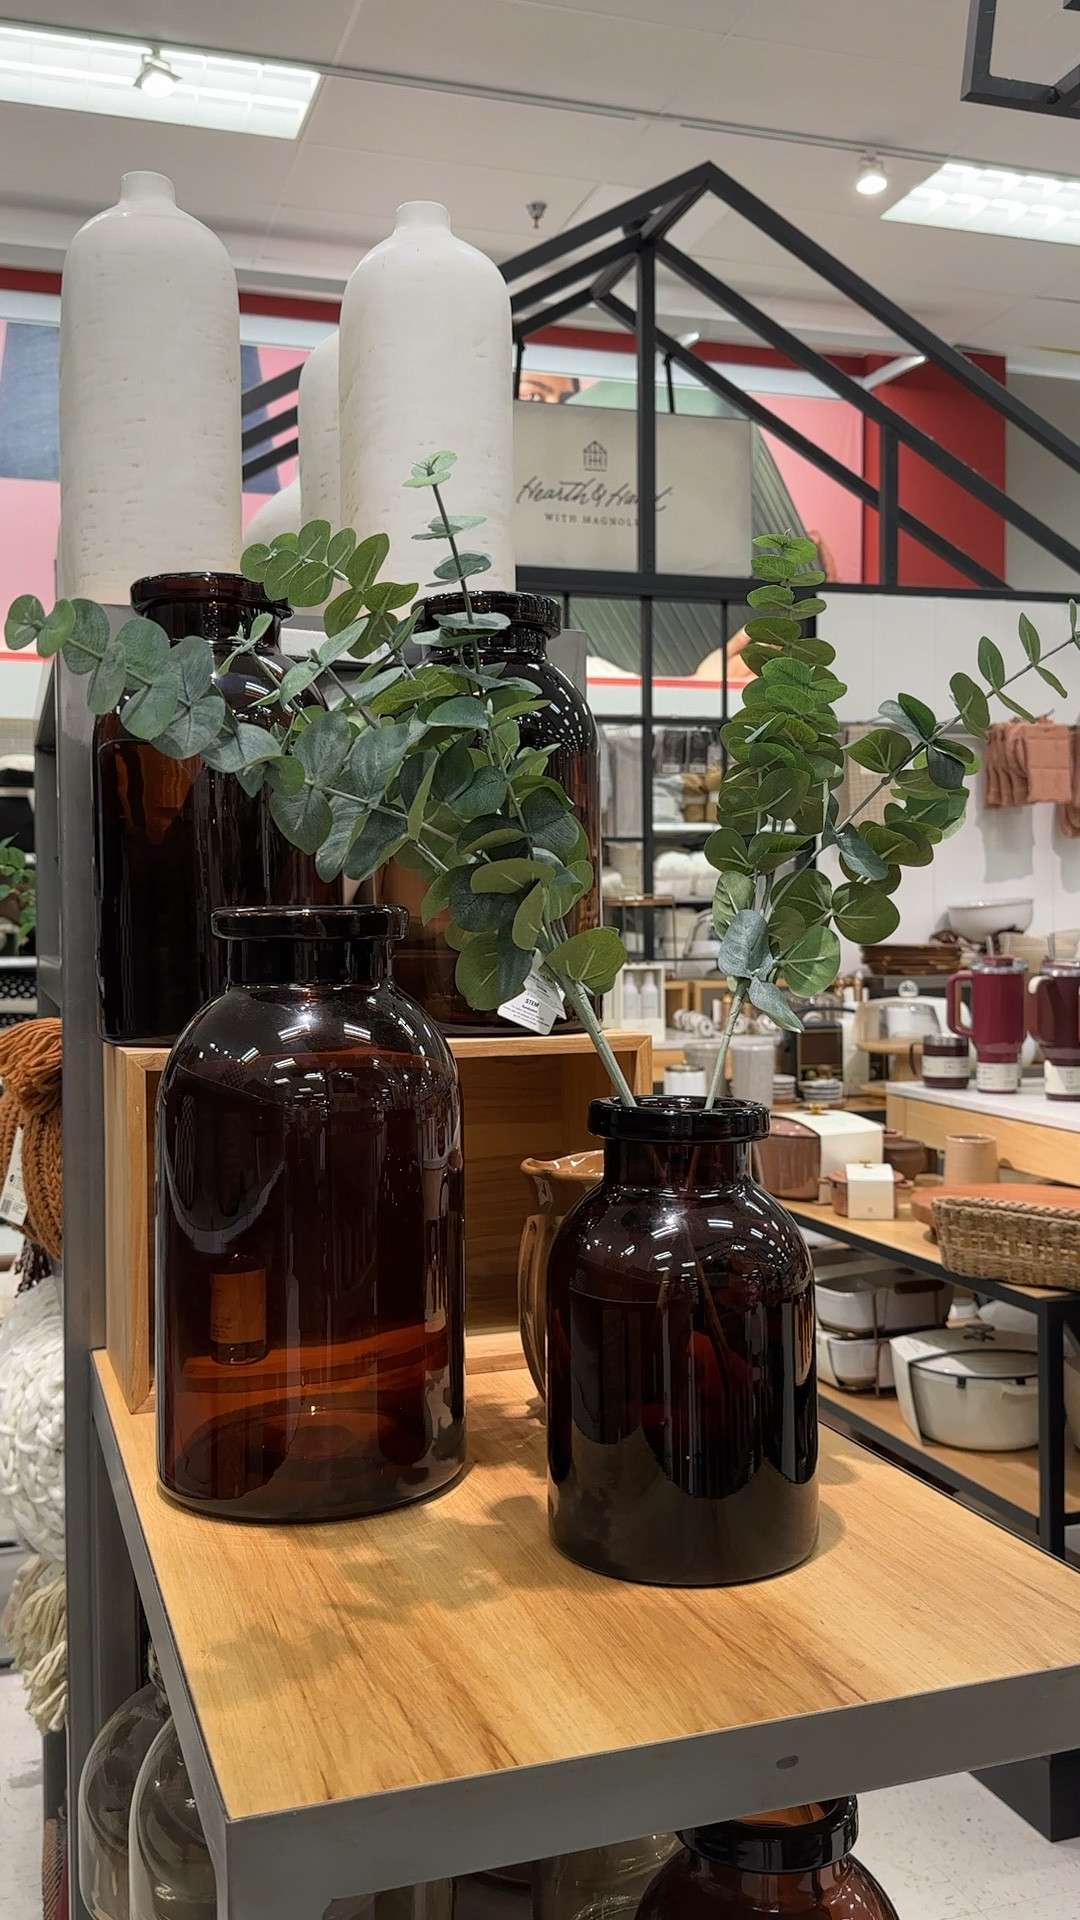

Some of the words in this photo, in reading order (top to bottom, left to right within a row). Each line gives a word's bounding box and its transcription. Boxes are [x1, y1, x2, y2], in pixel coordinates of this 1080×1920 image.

[515, 475, 596, 505] Hearth
[591, 482, 608, 507] &
[604, 482, 673, 512] Had
[544, 512, 577, 523] WITH
[582, 515, 639, 527] MAGNOL
[525, 998, 540, 1008] STEM
